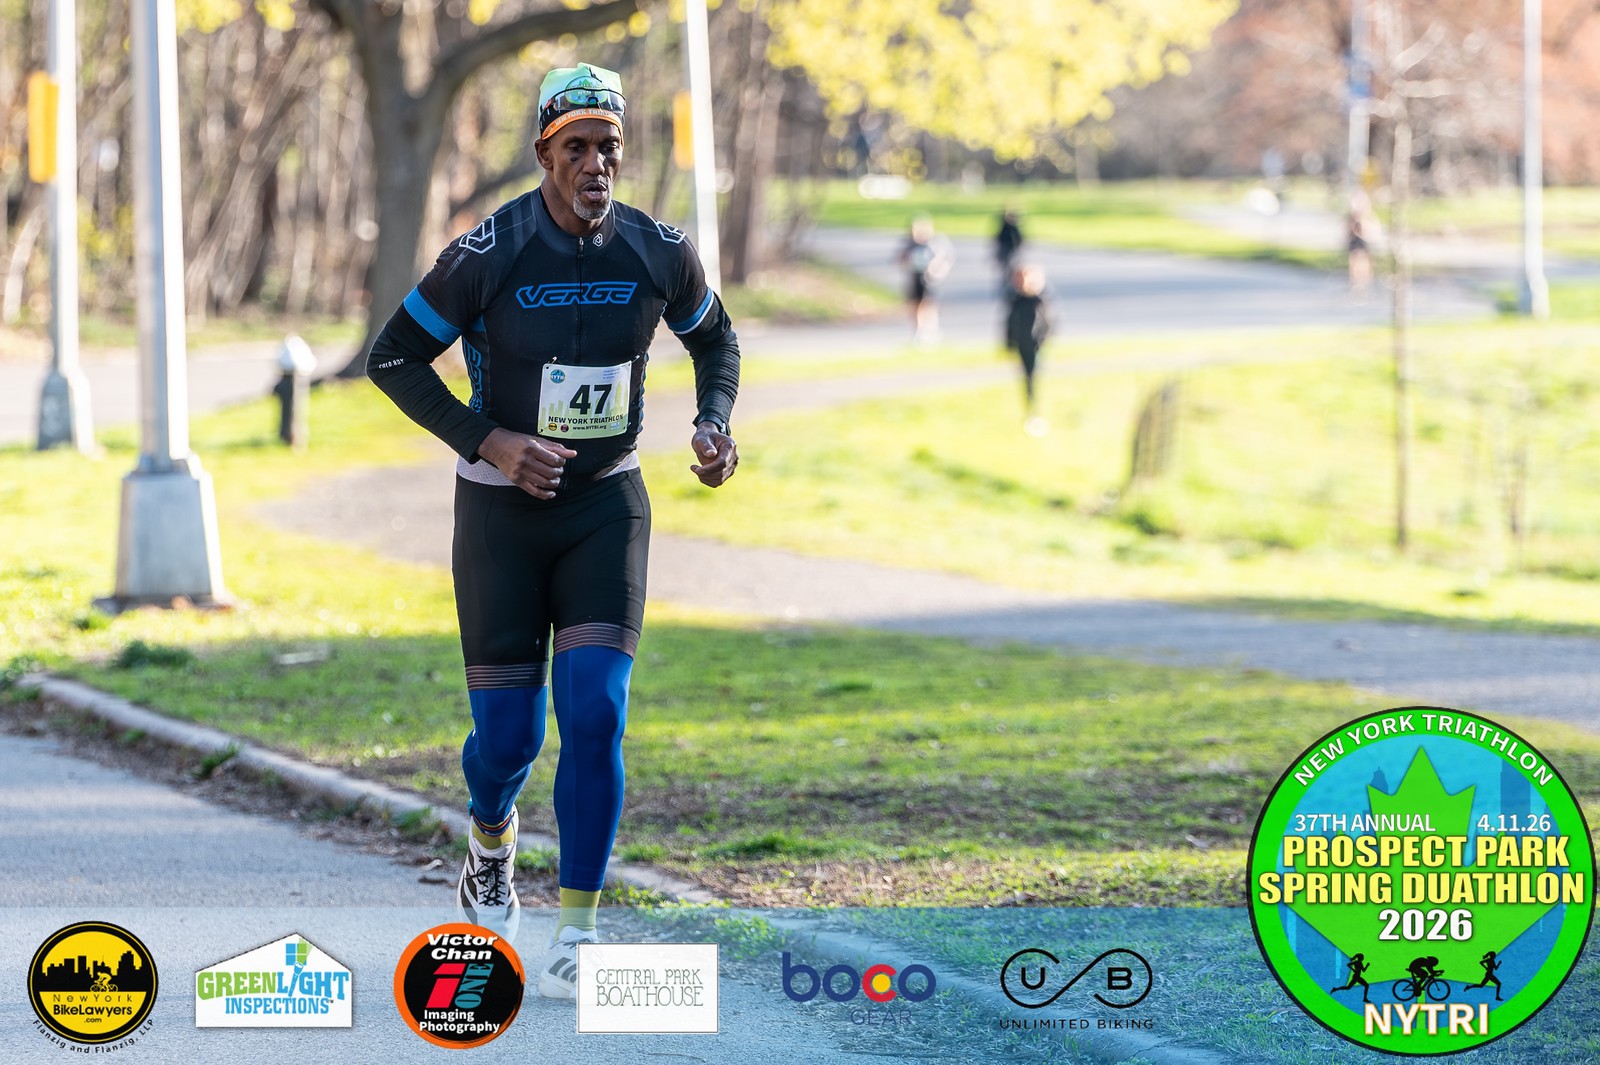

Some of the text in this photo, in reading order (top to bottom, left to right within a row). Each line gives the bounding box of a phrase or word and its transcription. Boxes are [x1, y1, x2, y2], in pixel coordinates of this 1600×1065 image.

[567, 109, 587, 118] YORK
[515, 282, 638, 309] VERGE
[569, 384, 613, 415] 47
[548, 413, 624, 425] NEW YORK TRIATHLON
